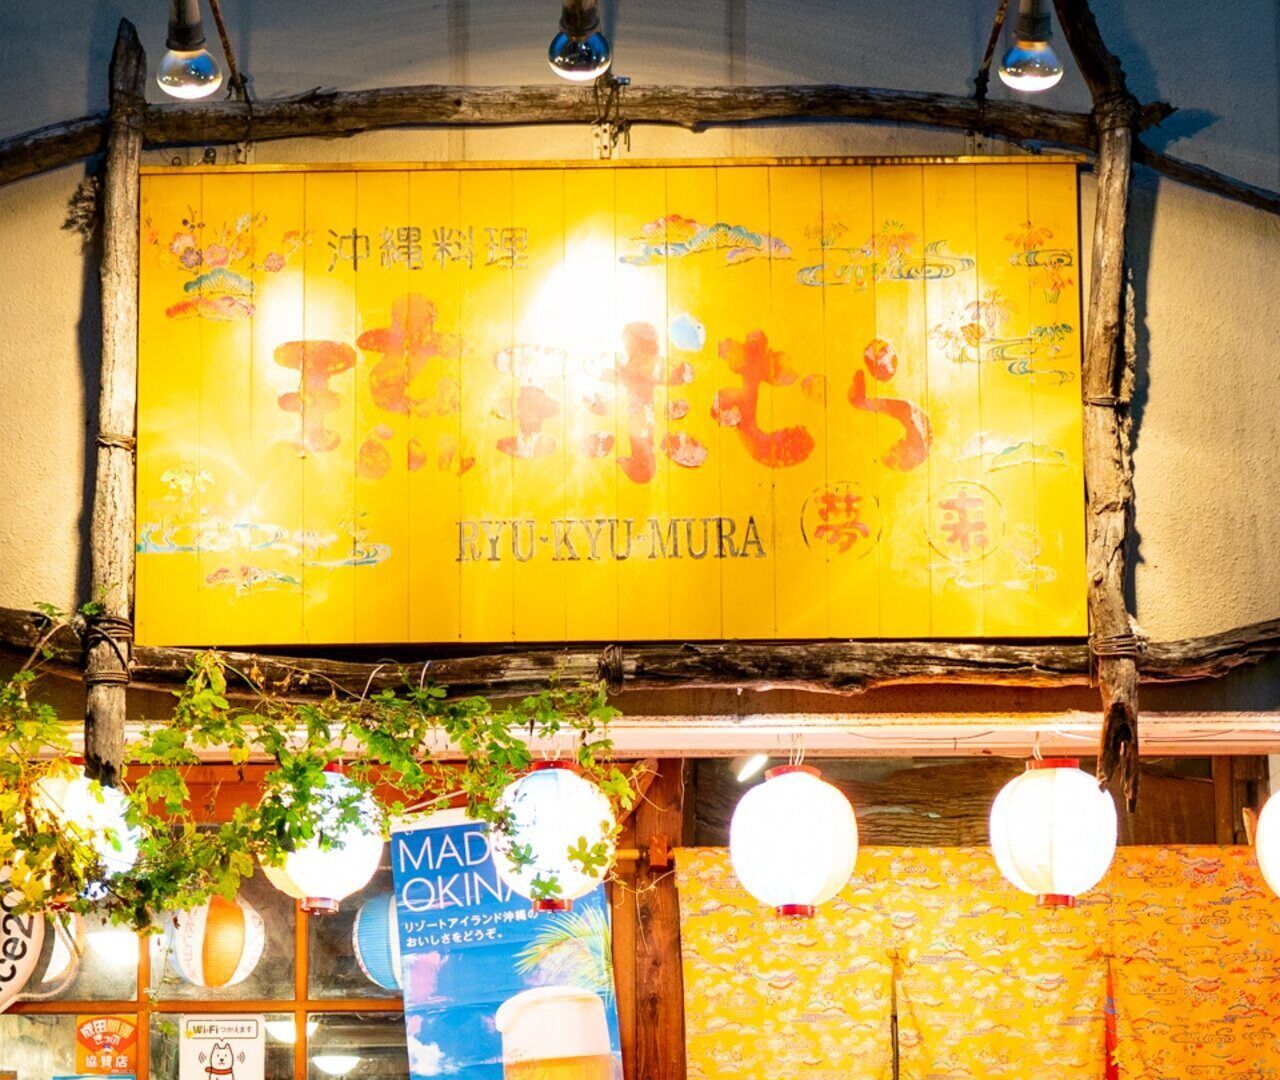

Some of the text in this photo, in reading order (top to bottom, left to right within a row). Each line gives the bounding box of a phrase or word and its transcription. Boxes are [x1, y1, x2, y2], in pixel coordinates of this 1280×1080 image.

[326, 226, 530, 273] 沖縄料理
[455, 515, 767, 562] RYU-KYU-MURA
[404, 909, 539, 934] リゾートアイランド沖縄の
[405, 928, 505, 949] おいしさをどうぞ。
